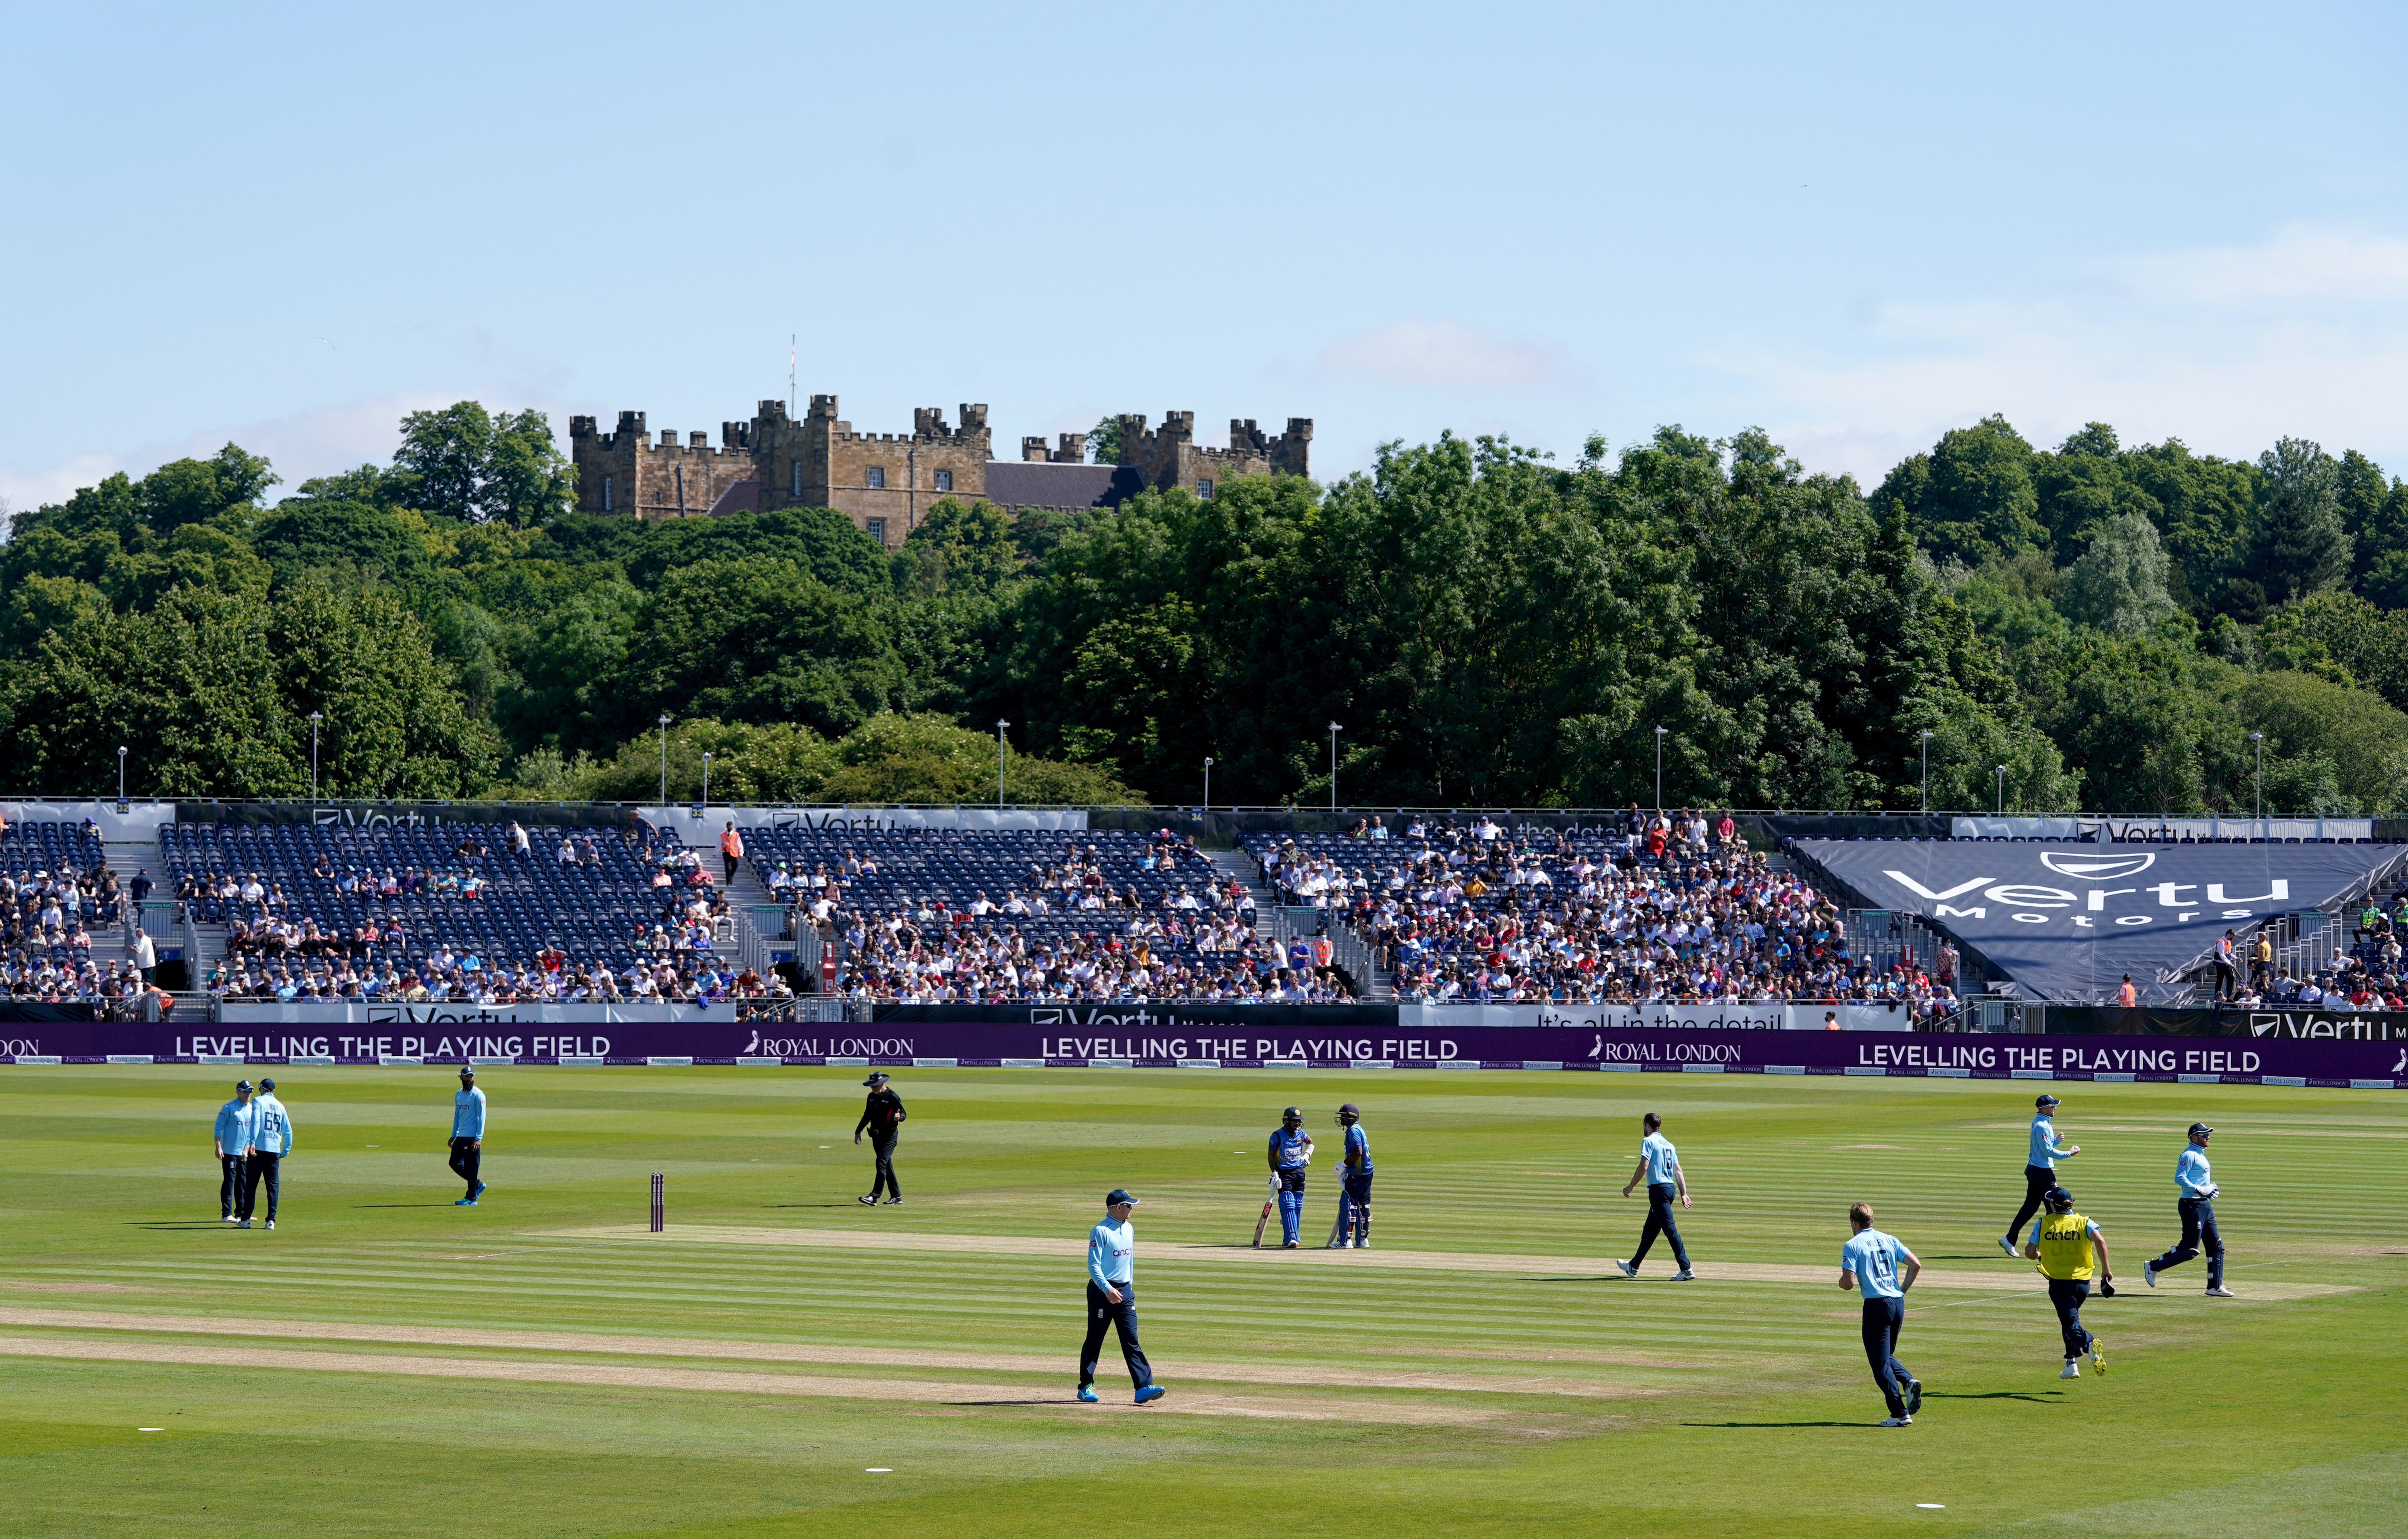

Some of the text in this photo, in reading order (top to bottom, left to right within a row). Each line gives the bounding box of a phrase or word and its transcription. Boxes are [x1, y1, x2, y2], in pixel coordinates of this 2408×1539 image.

[117, 804, 128, 812] 32
[692, 809, 703, 817] 33
[1882, 870, 2289, 911] Vertu
[1934, 903, 2253, 928] Motors
[2284, 1014, 2386, 1041] Vertu
[177, 1036, 610, 1056] LEVELLING THE PLAYING FIELD
[764, 1039, 913, 1056] ROYAL LONDON
[1043, 1038, 1458, 1060] LEVELLING THE PLAYING FIELD
[1606, 1043, 1741, 1062] ROYAL LONDON
[1860, 1045, 2260, 1072] LEVELLING THE PLAYING FIELD
[264, 1112, 281, 1133] 66
[1865, 1238, 1885, 1247] WILLEY
[2044, 1227, 2081, 1241] cinch
[1870, 1249, 1892, 1279] 15
